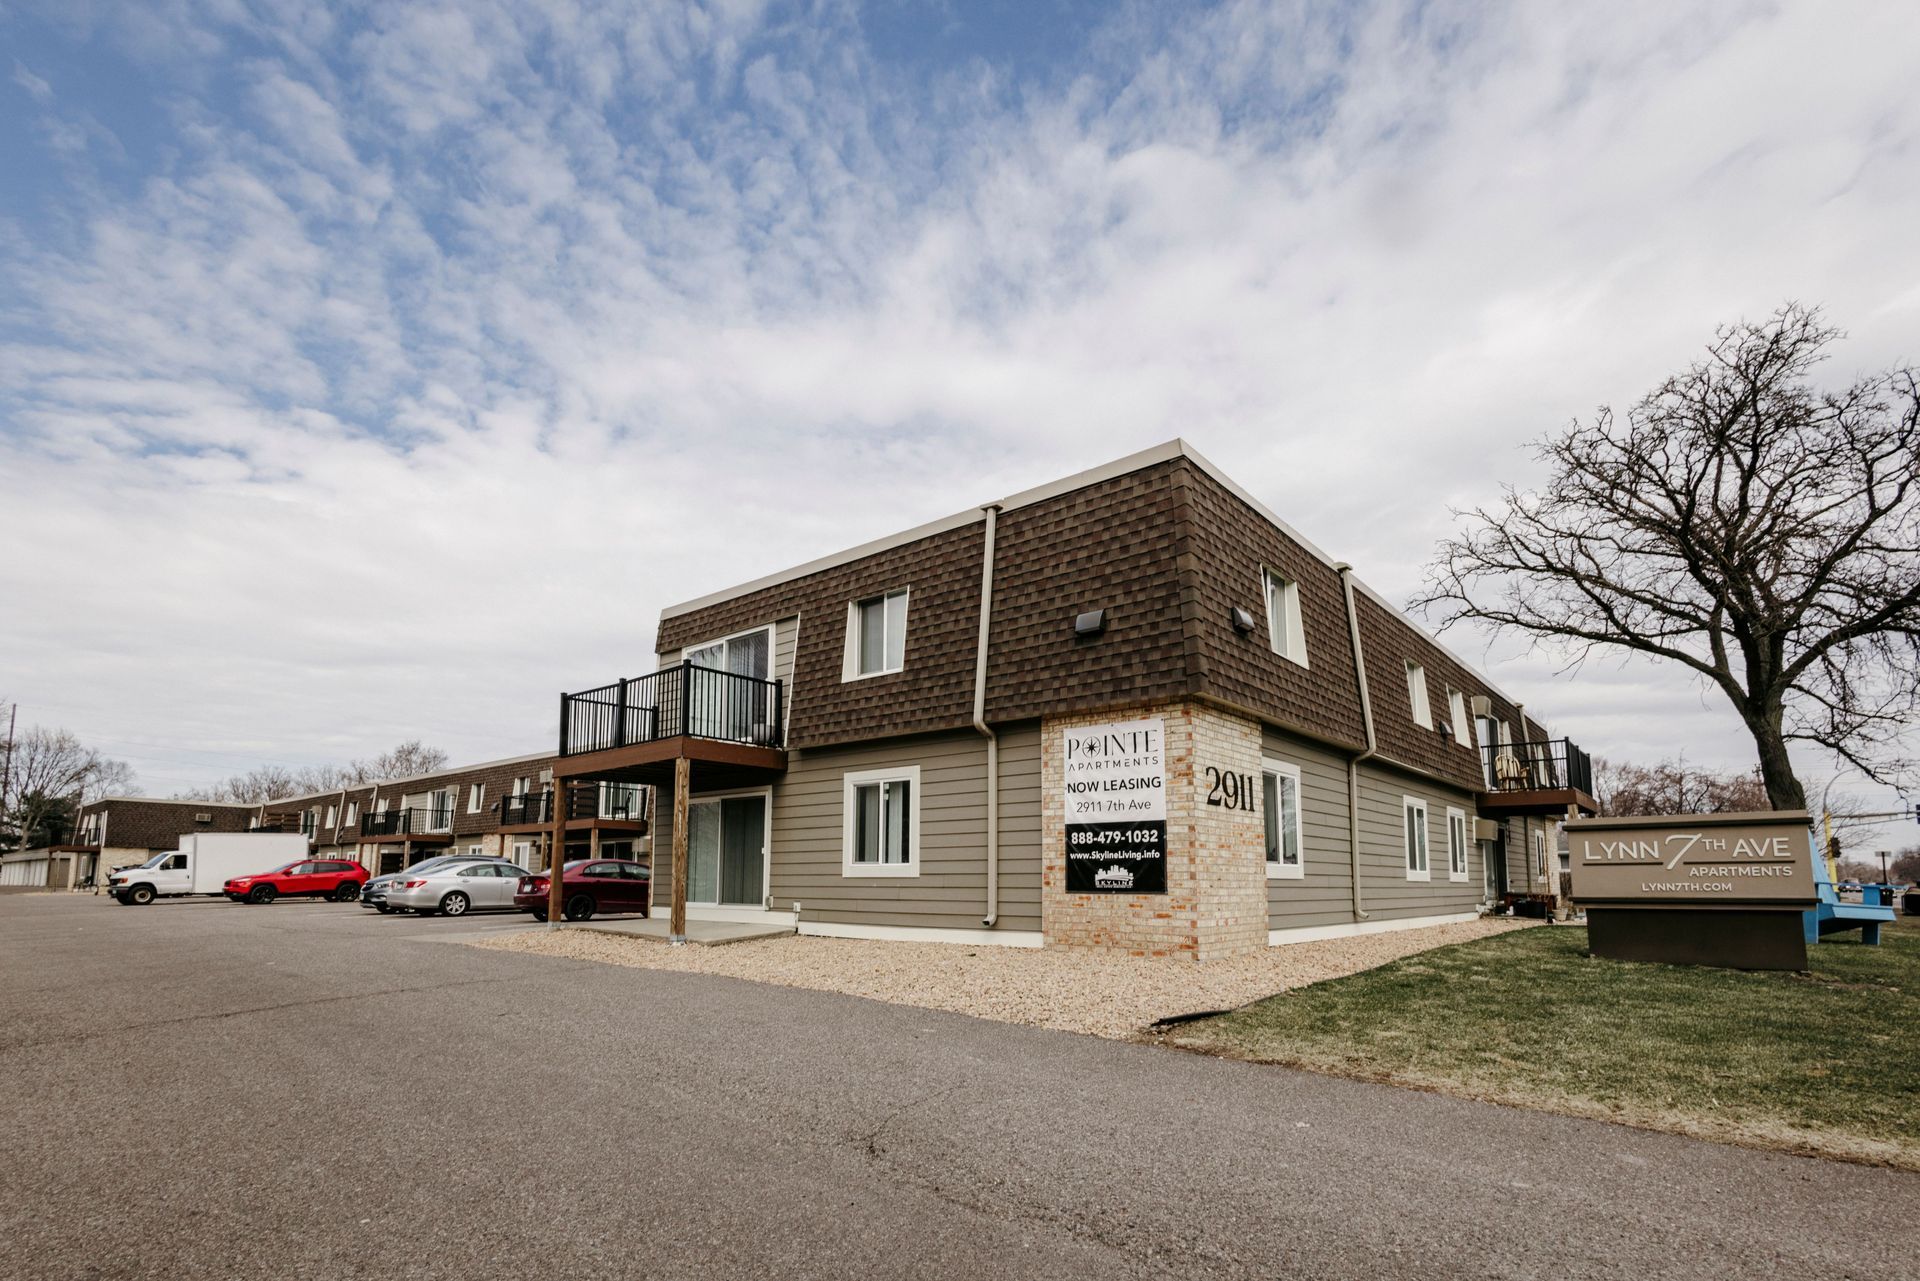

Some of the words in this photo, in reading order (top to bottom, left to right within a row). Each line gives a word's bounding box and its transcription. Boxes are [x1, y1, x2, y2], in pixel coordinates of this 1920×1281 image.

[1067, 729, 1159, 759] POINTE
[1068, 756, 1159, 772] APARTMENTS
[1067, 780, 1099, 794] NOW
[1103, 776, 1161, 792] LEASING
[1206, 766, 1255, 812] 2911
[1076, 801, 1102, 813] 2911
[1107, 800, 1125, 812] 7th
[1129, 799, 1151, 810] Ave
[1071, 829, 1159, 845] 888-479-1032
[1069, 850, 1160, 862] www.SkylineLiving.info
[1583, 840, 1659, 860] LYNN
[1732, 837, 1792, 858] AVE
[1689, 866, 1793, 878] APARTMENTS
[1641, 882, 1732, 893] LYNN7TH.COM
